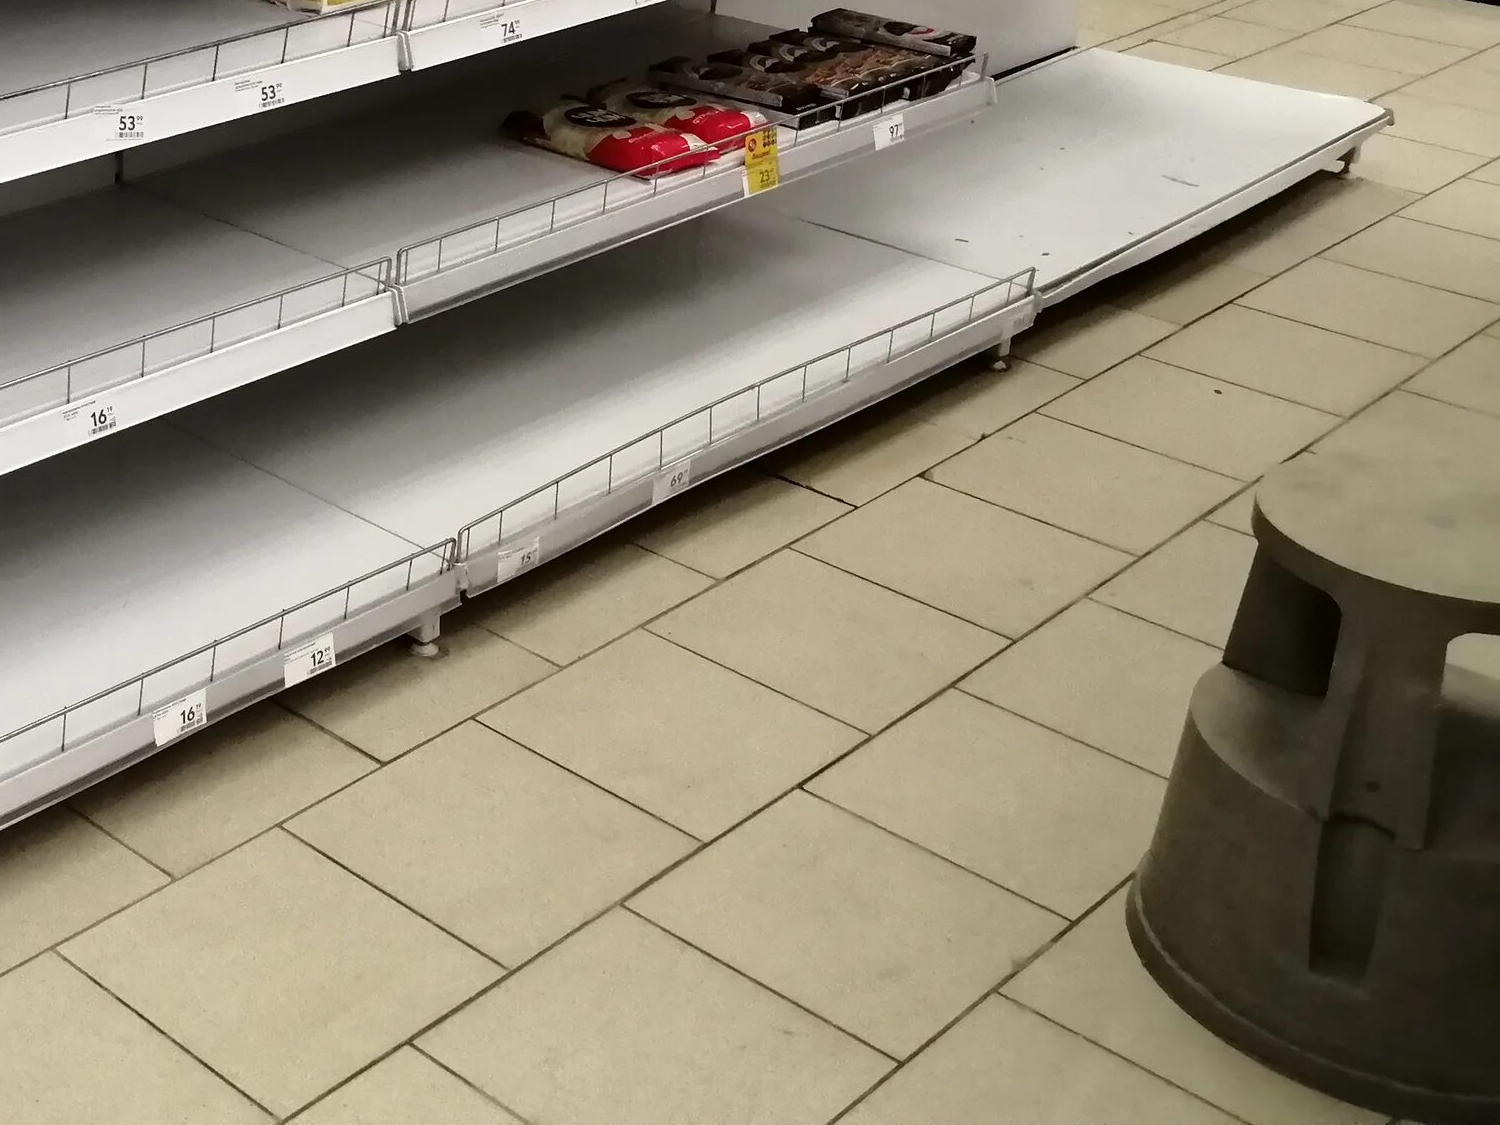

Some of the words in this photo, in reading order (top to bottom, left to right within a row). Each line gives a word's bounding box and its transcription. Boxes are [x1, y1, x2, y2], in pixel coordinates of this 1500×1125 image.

[501, 21, 515, 37] 74
[261, 84, 276, 101] 53
[118, 115, 136, 131] 53
[889, 125, 900, 139] 97
[759, 170, 771, 184] 23
[90, 408, 107, 427] 16
[311, 650, 324, 667] 12
[181, 706, 195, 724] 16
